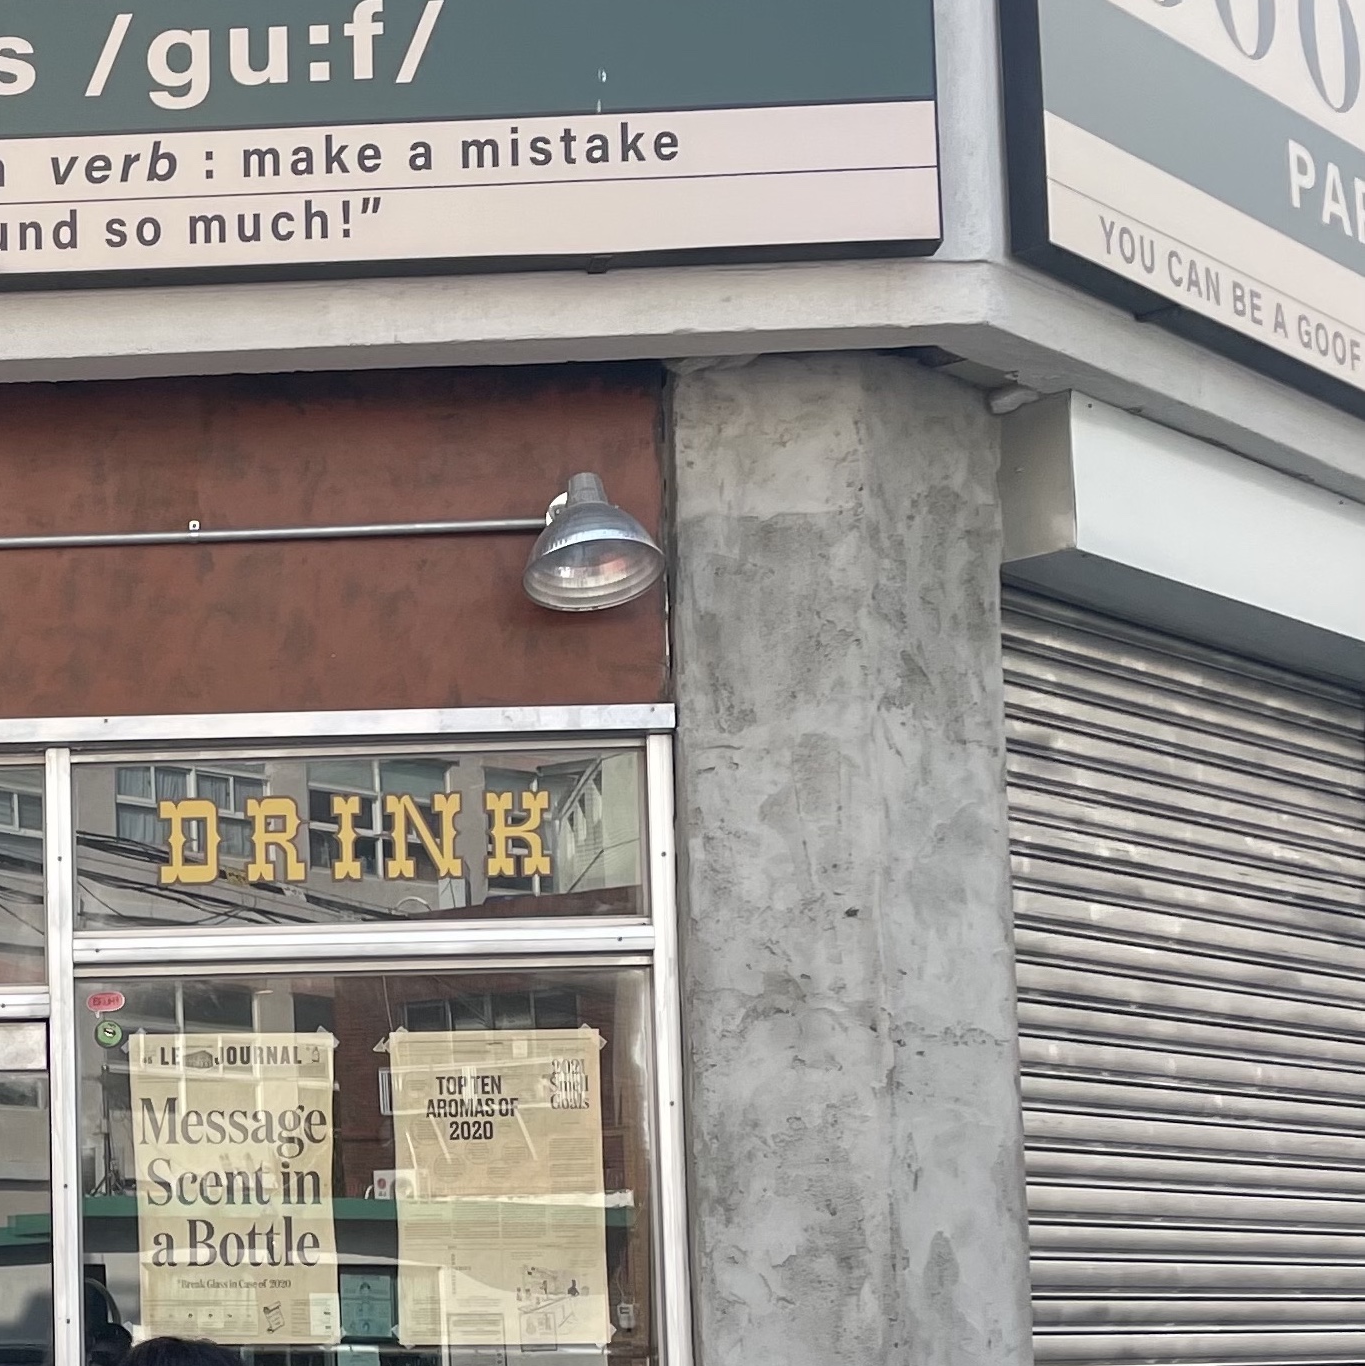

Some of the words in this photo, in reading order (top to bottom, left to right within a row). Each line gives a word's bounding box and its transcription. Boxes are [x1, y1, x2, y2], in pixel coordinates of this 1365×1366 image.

[84, 0, 446, 110] /gu:f/
[51, 140, 177, 186] verb
[242, 135, 382, 178] make
[408, 141, 433, 172] a
[460, 123, 679, 169] mistake
[105, 216, 162, 248] so
[1099, 215, 1155, 274] YOU
[1168, 250, 1221, 306] CAN
[1233, 280, 1263, 326] BE
[1274, 302, 1289, 339] A
[1298, 314, 1361, 371] GOOF
[157, 789, 552, 886] DRINK
[160, 1046, 180, 1066] LE
[214, 1045, 302, 1066] JOURNAL
[426, 1098, 494, 1118] AROMAS
[499, 1098, 518, 1117] OF
[436, 1076, 466, 1095] TOP
[471, 1075, 501, 1094] TEN
[139, 1097, 327, 1159] Message
[449, 1120, 493, 1140] 2020
[147, 1157, 272, 1206] Scent
[281, 1160, 322, 1205] in
[152, 1232, 177, 1267] a
[186, 1216, 320, 1267] Bottle
